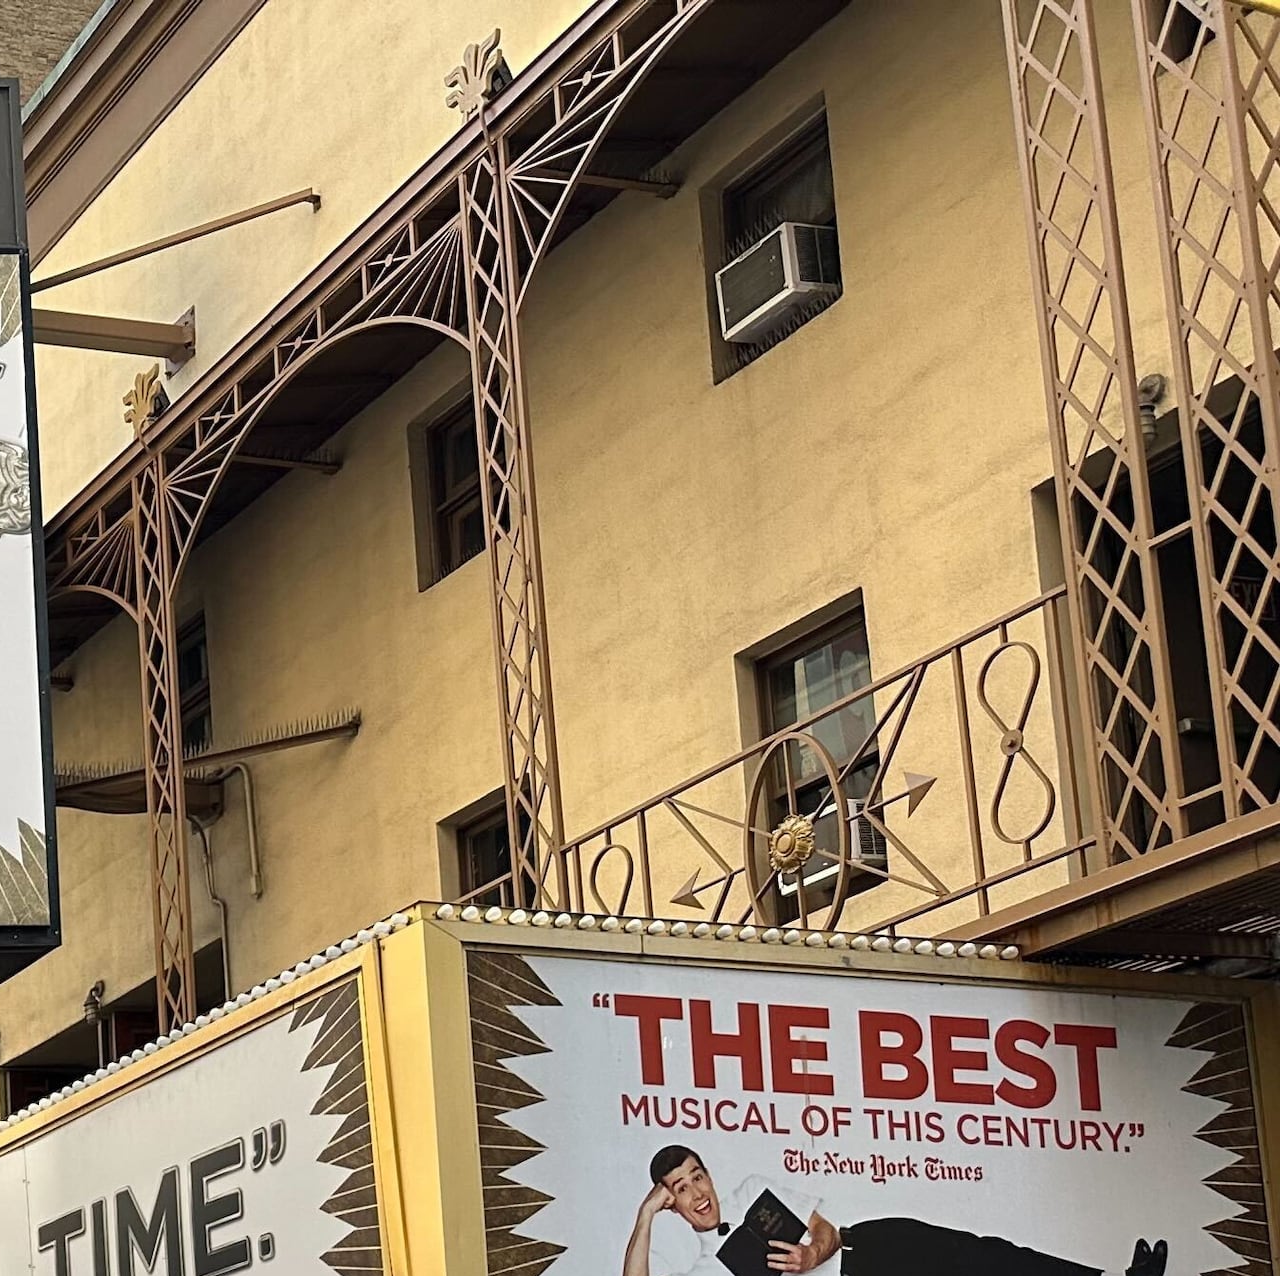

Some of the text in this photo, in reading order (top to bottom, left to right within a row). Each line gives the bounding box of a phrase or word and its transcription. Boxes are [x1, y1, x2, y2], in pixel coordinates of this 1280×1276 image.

[858, 1010, 1117, 1112] BEST
[622, 1094, 790, 1135] MUSICAL
[805, 1105, 851, 1138] OF
[864, 1109, 945, 1144] THIS
[783, 1149, 983, 1184] The New York Times
